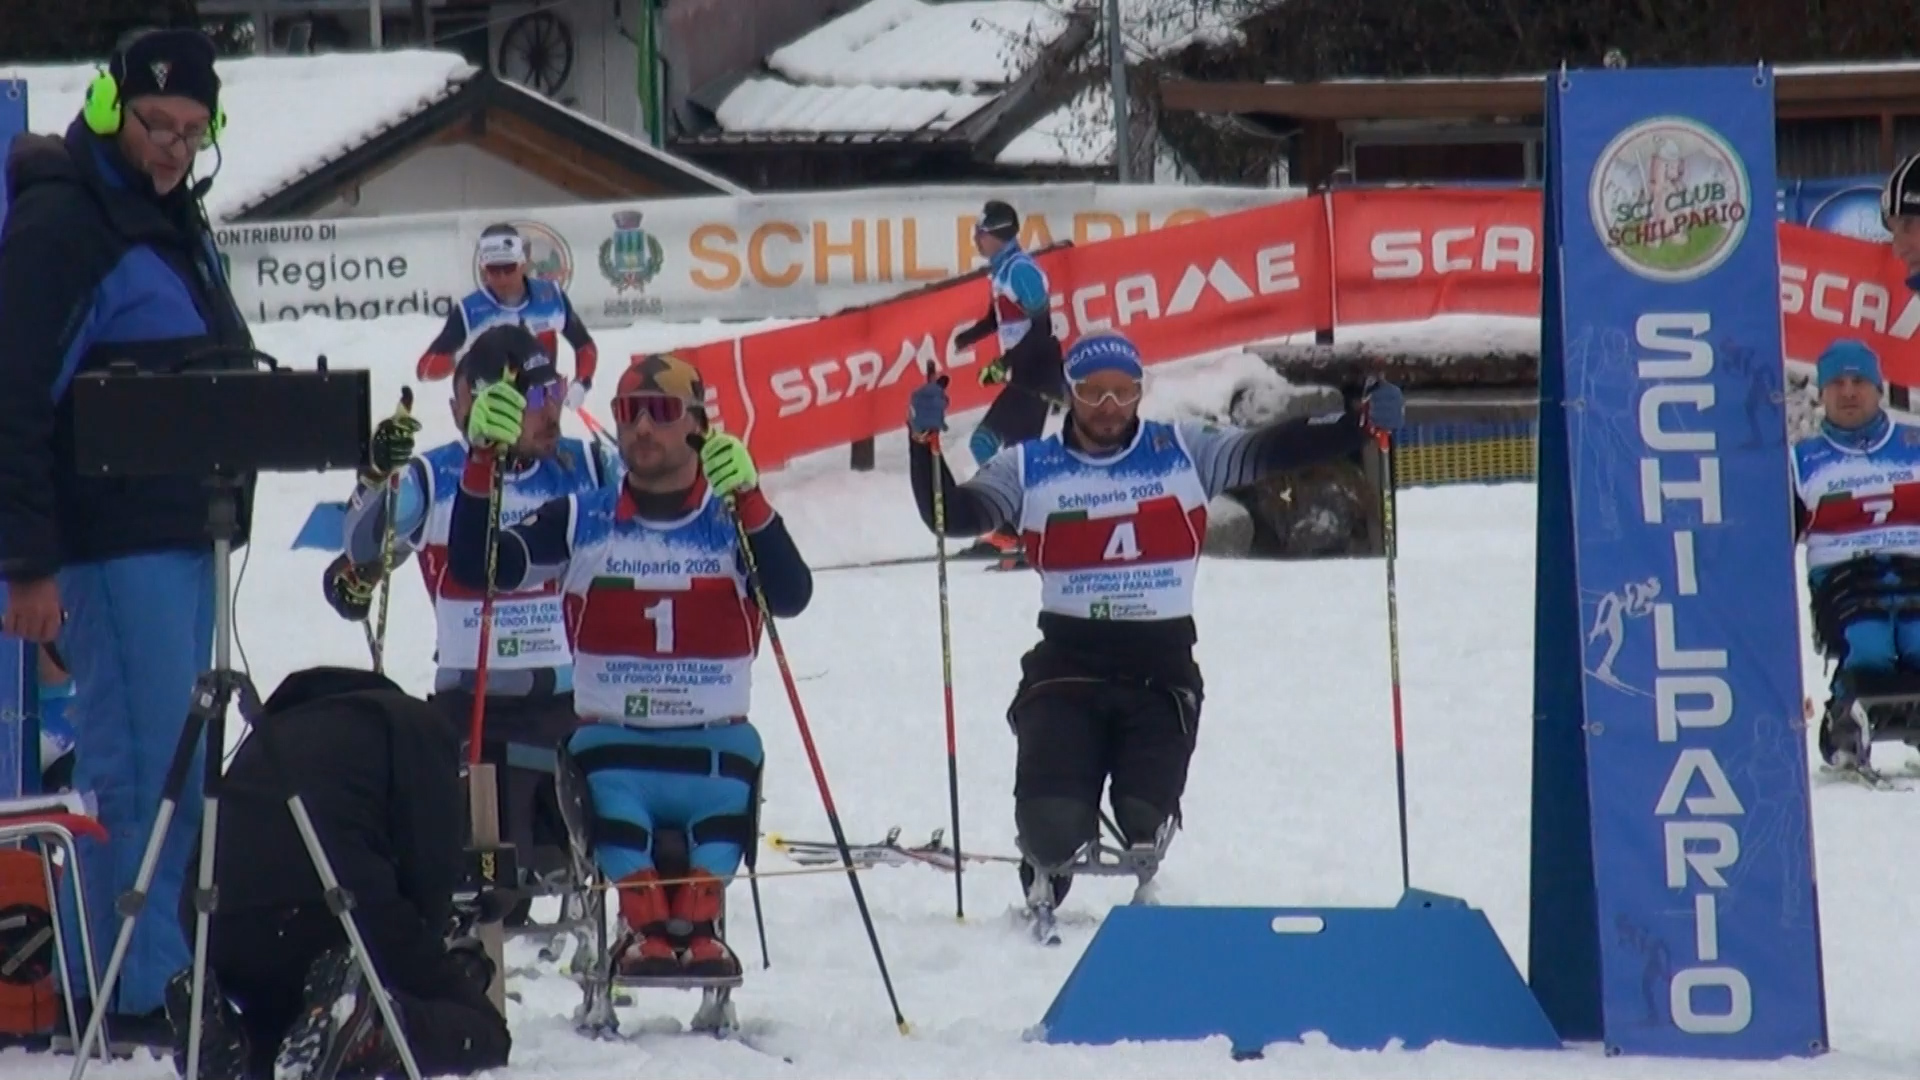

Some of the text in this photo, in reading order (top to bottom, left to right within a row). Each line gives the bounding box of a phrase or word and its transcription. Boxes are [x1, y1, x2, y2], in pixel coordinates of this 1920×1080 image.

[1665, 183, 1726, 212] CLUB
[214, 224, 336, 246] ONTRIBUTO DI
[1607, 201, 1745, 248] SCHILPARIO
[257, 253, 408, 290] Regione
[1057, 481, 1164, 509] Schilpario 2026
[1862, 500, 1895, 524] 7
[1103, 521, 1143, 561] 4
[605, 557, 721, 576] Schilpario 2026
[643, 599, 674, 653] 1
[1635, 312, 1752, 1034] SCHILPARIO
